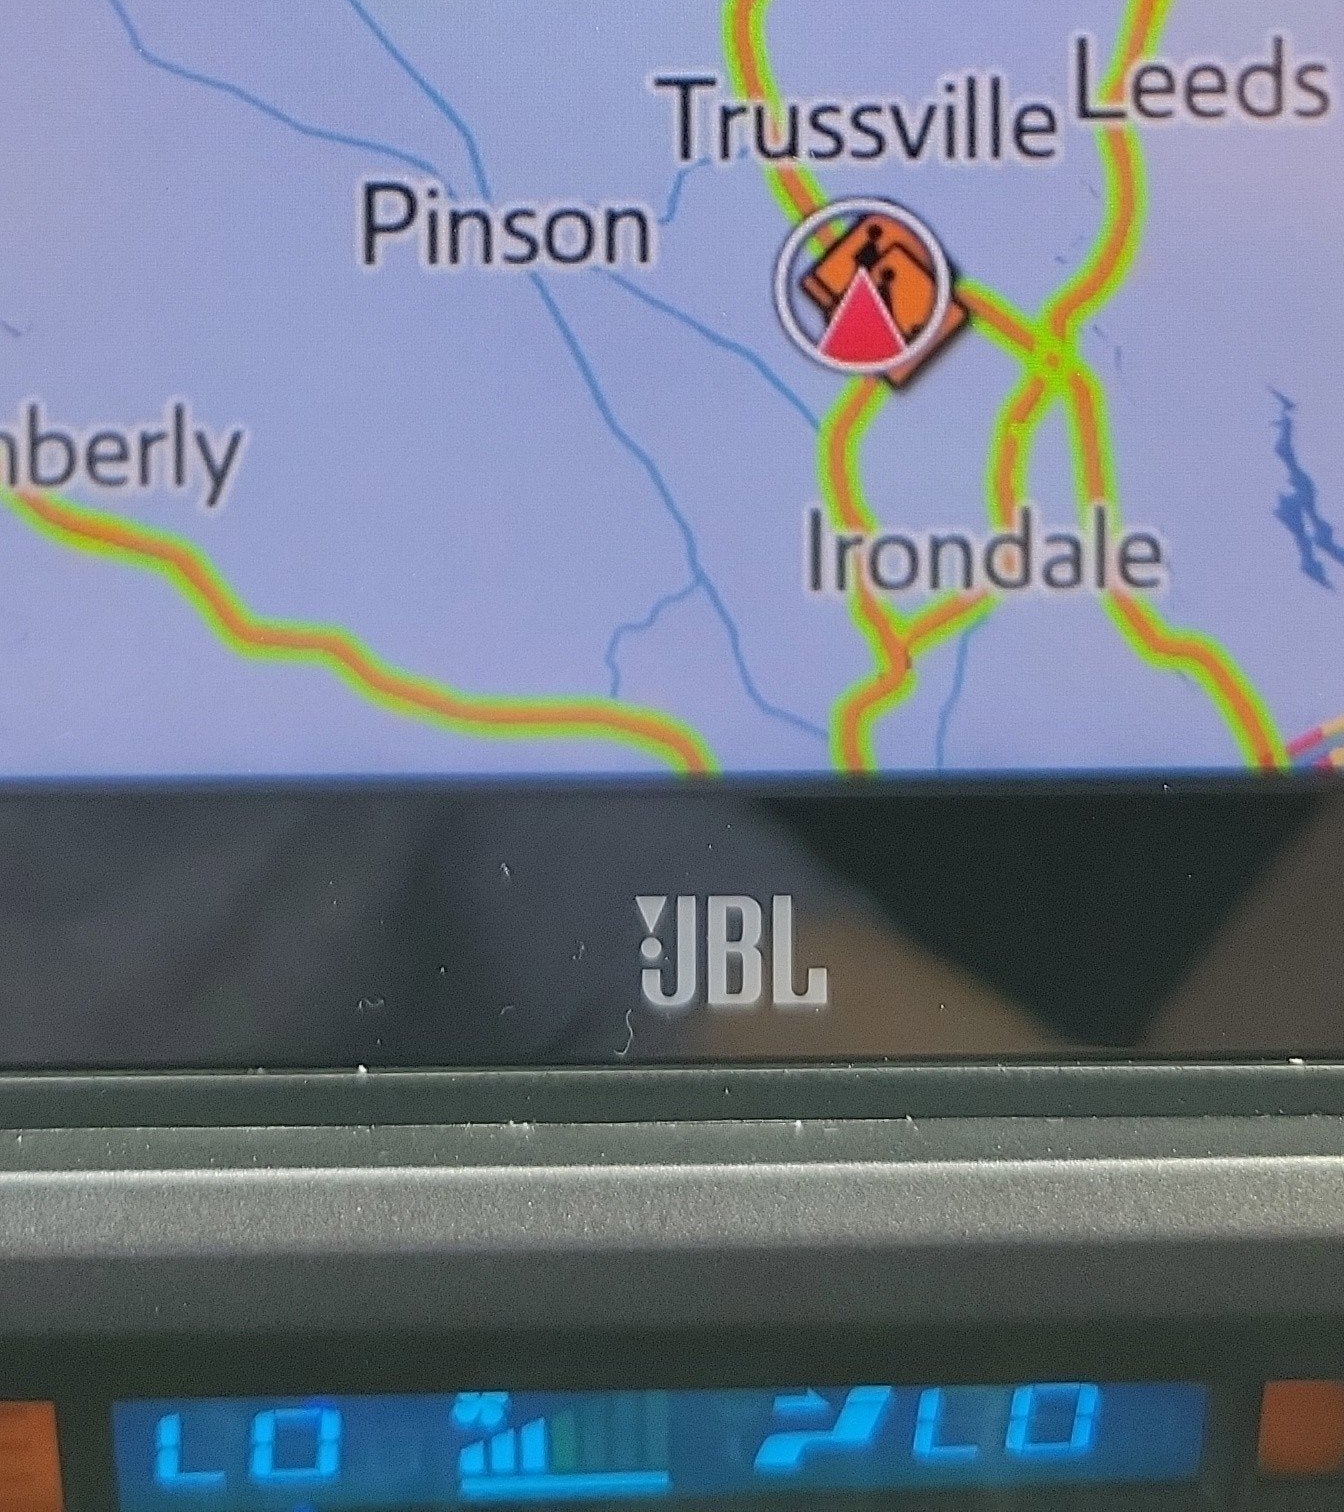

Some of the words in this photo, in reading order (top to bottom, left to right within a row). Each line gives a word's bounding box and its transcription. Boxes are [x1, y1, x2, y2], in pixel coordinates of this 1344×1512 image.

[654, 74, 1058, 162] Trussville
[1074, 35, 1332, 122] Leeds
[360, 181, 652, 266] Pinson
[808, 506, 1162, 592] Irondale
[639, 894, 828, 1006] JBL
